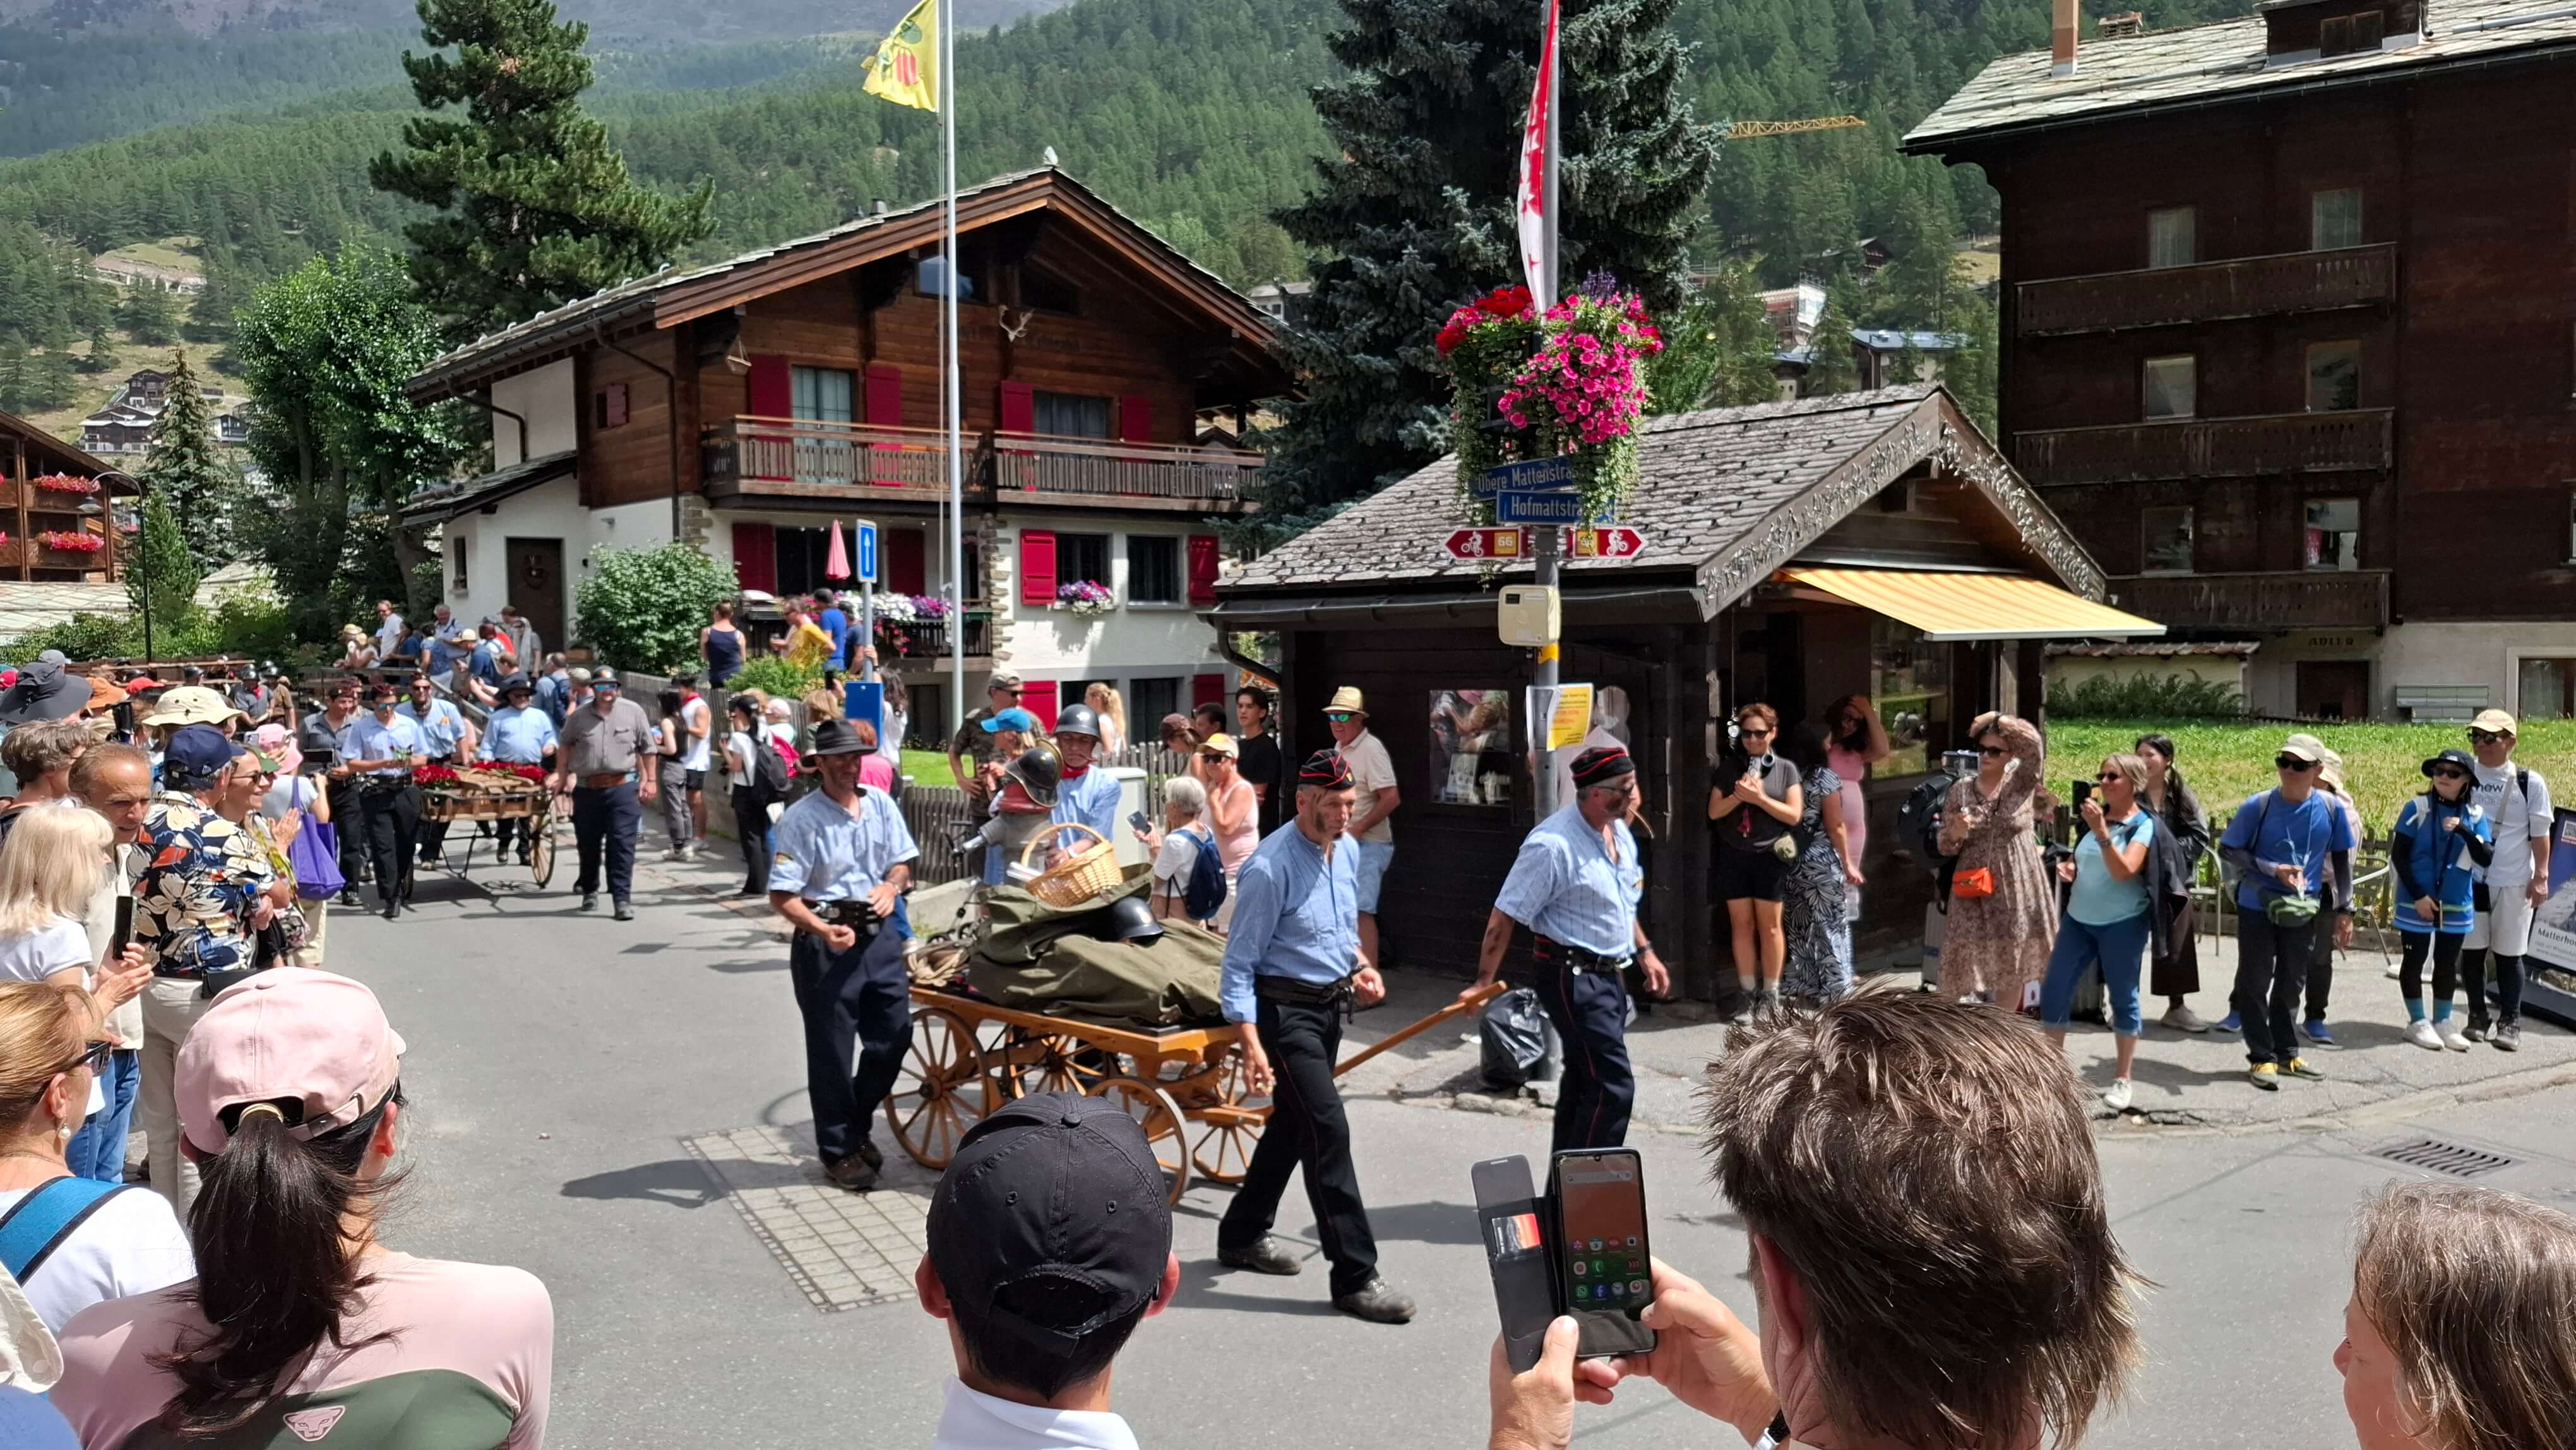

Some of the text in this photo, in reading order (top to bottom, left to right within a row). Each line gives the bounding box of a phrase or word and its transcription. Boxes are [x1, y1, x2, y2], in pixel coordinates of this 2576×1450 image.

[1478, 464, 1573, 493] Obere Mattenstra
[1511, 494, 1585, 517] Hofmattstra
[1497, 536, 1513, 546] 66
[2537, 927, 2576, 947] Matterho
